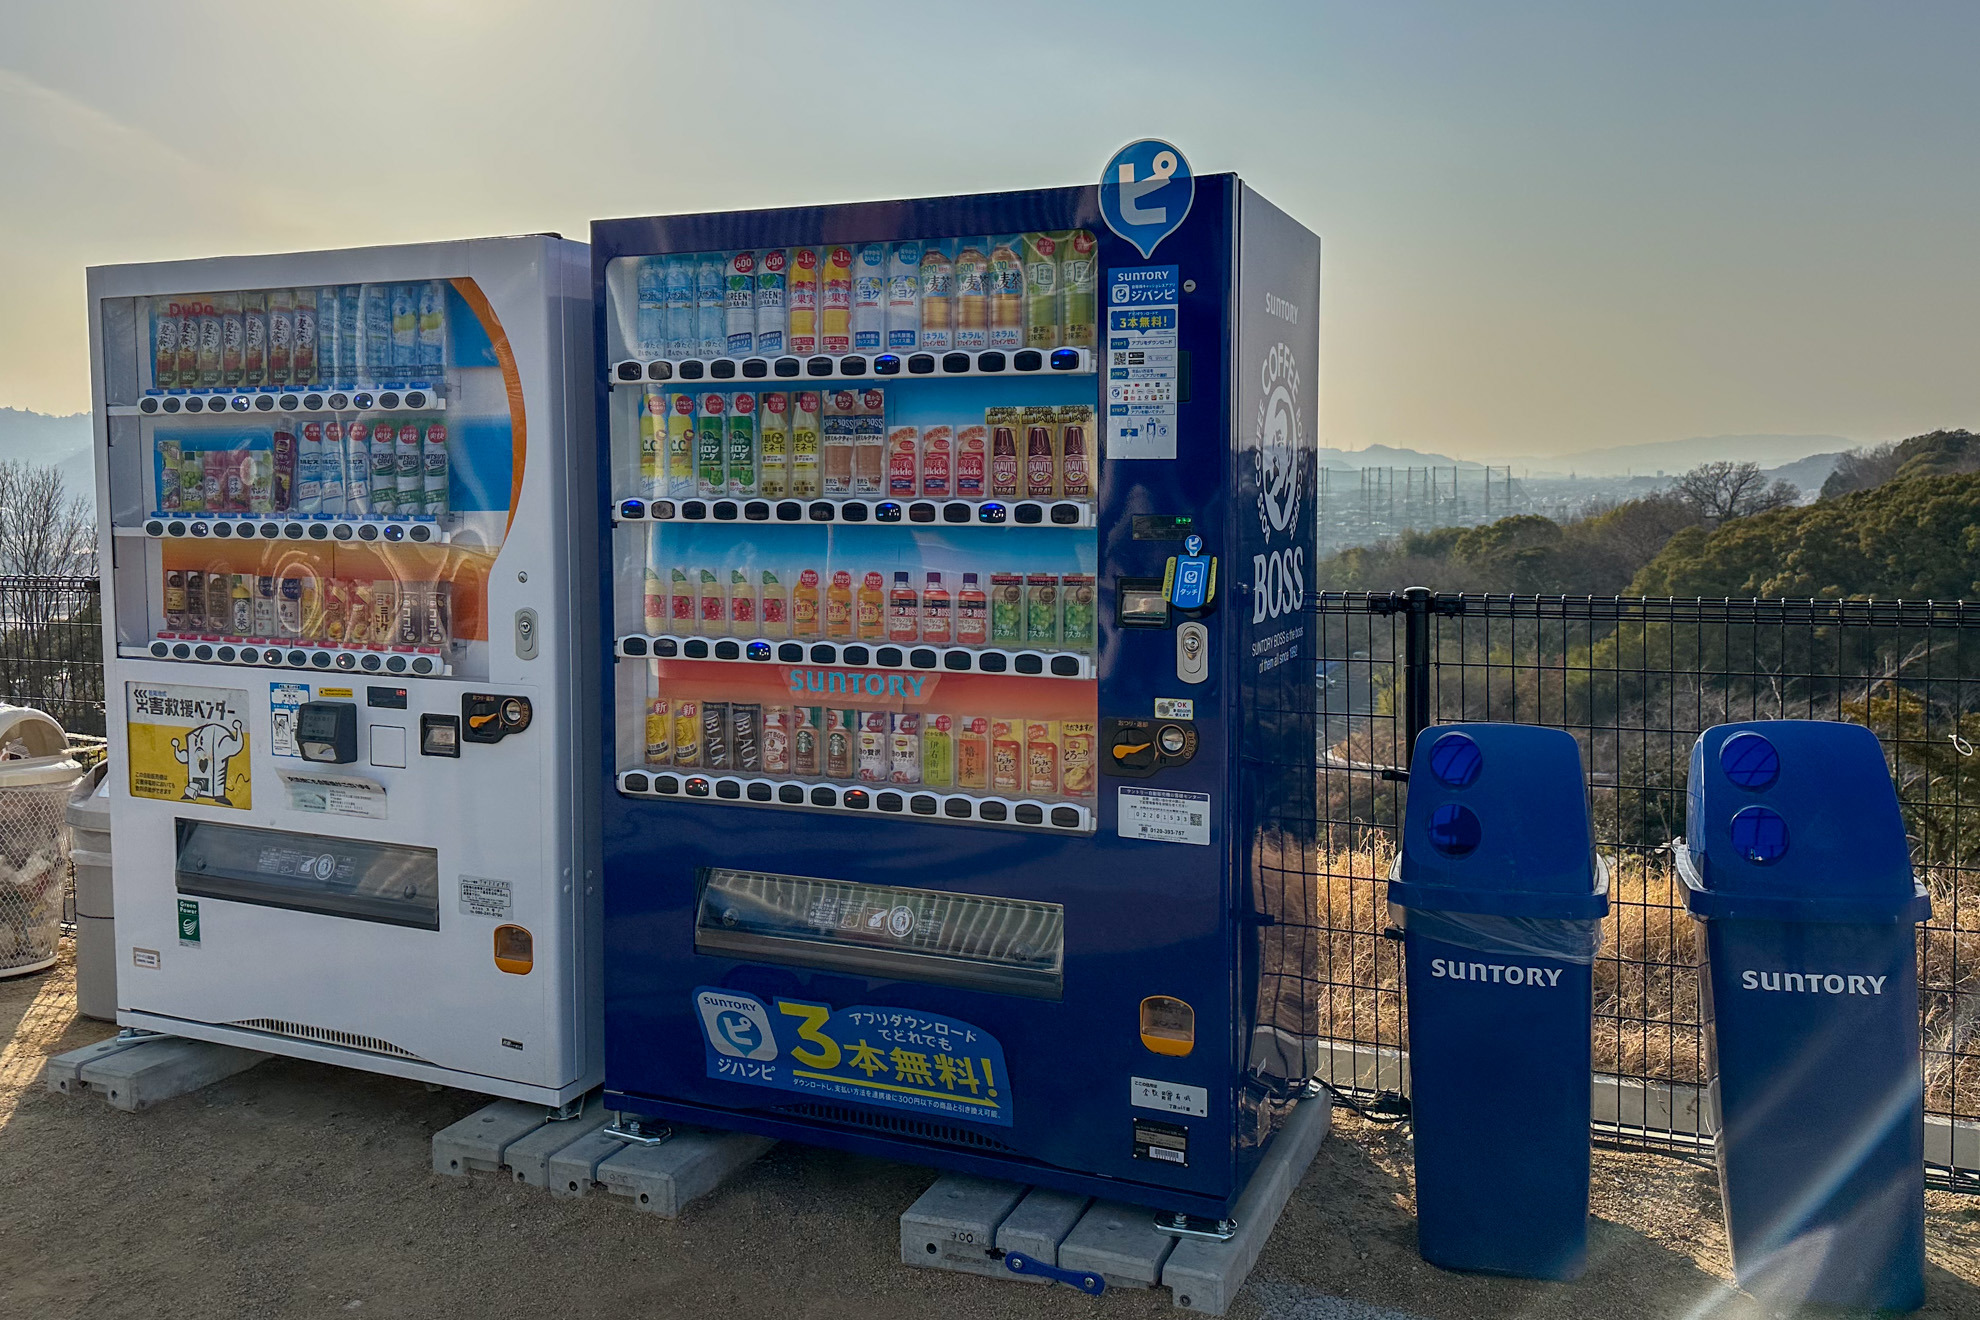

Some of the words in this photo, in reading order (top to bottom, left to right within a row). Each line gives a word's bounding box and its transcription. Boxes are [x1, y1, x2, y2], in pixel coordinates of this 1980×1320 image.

[1119, 151, 1178, 226] ピ
[735, 258, 752, 268] 600
[766, 256, 783, 266] 600
[931, 276, 952, 293] 麦茶
[967, 274, 989, 292] 麦茶
[1000, 272, 1021, 289] 麦茶
[1117, 270, 1169, 282] SUNTORY
[169, 301, 214, 321] DyDo
[1265, 291, 1298, 325] SUNTORY
[1119, 315, 1168, 328] 3本無料!
[1261, 342, 1299, 404] COFFEE
[770, 402, 785, 410] 京都
[730, 444, 749, 453] メロン
[731, 452, 748, 460] ソーダ
[891, 467, 913, 475] Bikkle
[925, 467, 946, 475] Bikkle
[959, 467, 981, 475] Bikkle
[1188, 537, 1200, 550] ピ
[1180, 588, 1198, 596] タッチ
[1252, 545, 1304, 625] BOSS
[905, 608, 918, 616] BOSS
[938, 608, 951, 616] BOSS
[973, 609, 987, 618] BOSS
[403, 608, 411, 637] ココア
[429, 608, 438, 637] ココア
[1273, 630, 1286, 649] BOSS
[790, 669, 926, 698] SUNTORY
[655, 701, 667, 713] 新
[683, 704, 695, 716] 新
[868, 719, 883, 727] 濃厚
[902, 721, 916, 729] 濃厚
[704, 716, 727, 767] BLACK
[736, 718, 759, 769] BLACK
[930, 740, 939, 779] 伊右衛門
[965, 745, 976, 779] 焙じ茶
[1064, 748, 1089, 760] とろーり
[1034, 766, 1052, 774] レモン
[1430, 957, 1564, 988] SUNTORY
[1741, 969, 1887, 996] SUNTORY
[703, 996, 757, 1013] SUNTORY
[723, 1016, 754, 1046] ピ
[849, 1012, 978, 1043] アプリダウンロード
[878, 1028, 953, 1052] でどれでも
[778, 1001, 998, 1098] 3本無料!
[717, 1058, 776, 1081] ジハンピ
